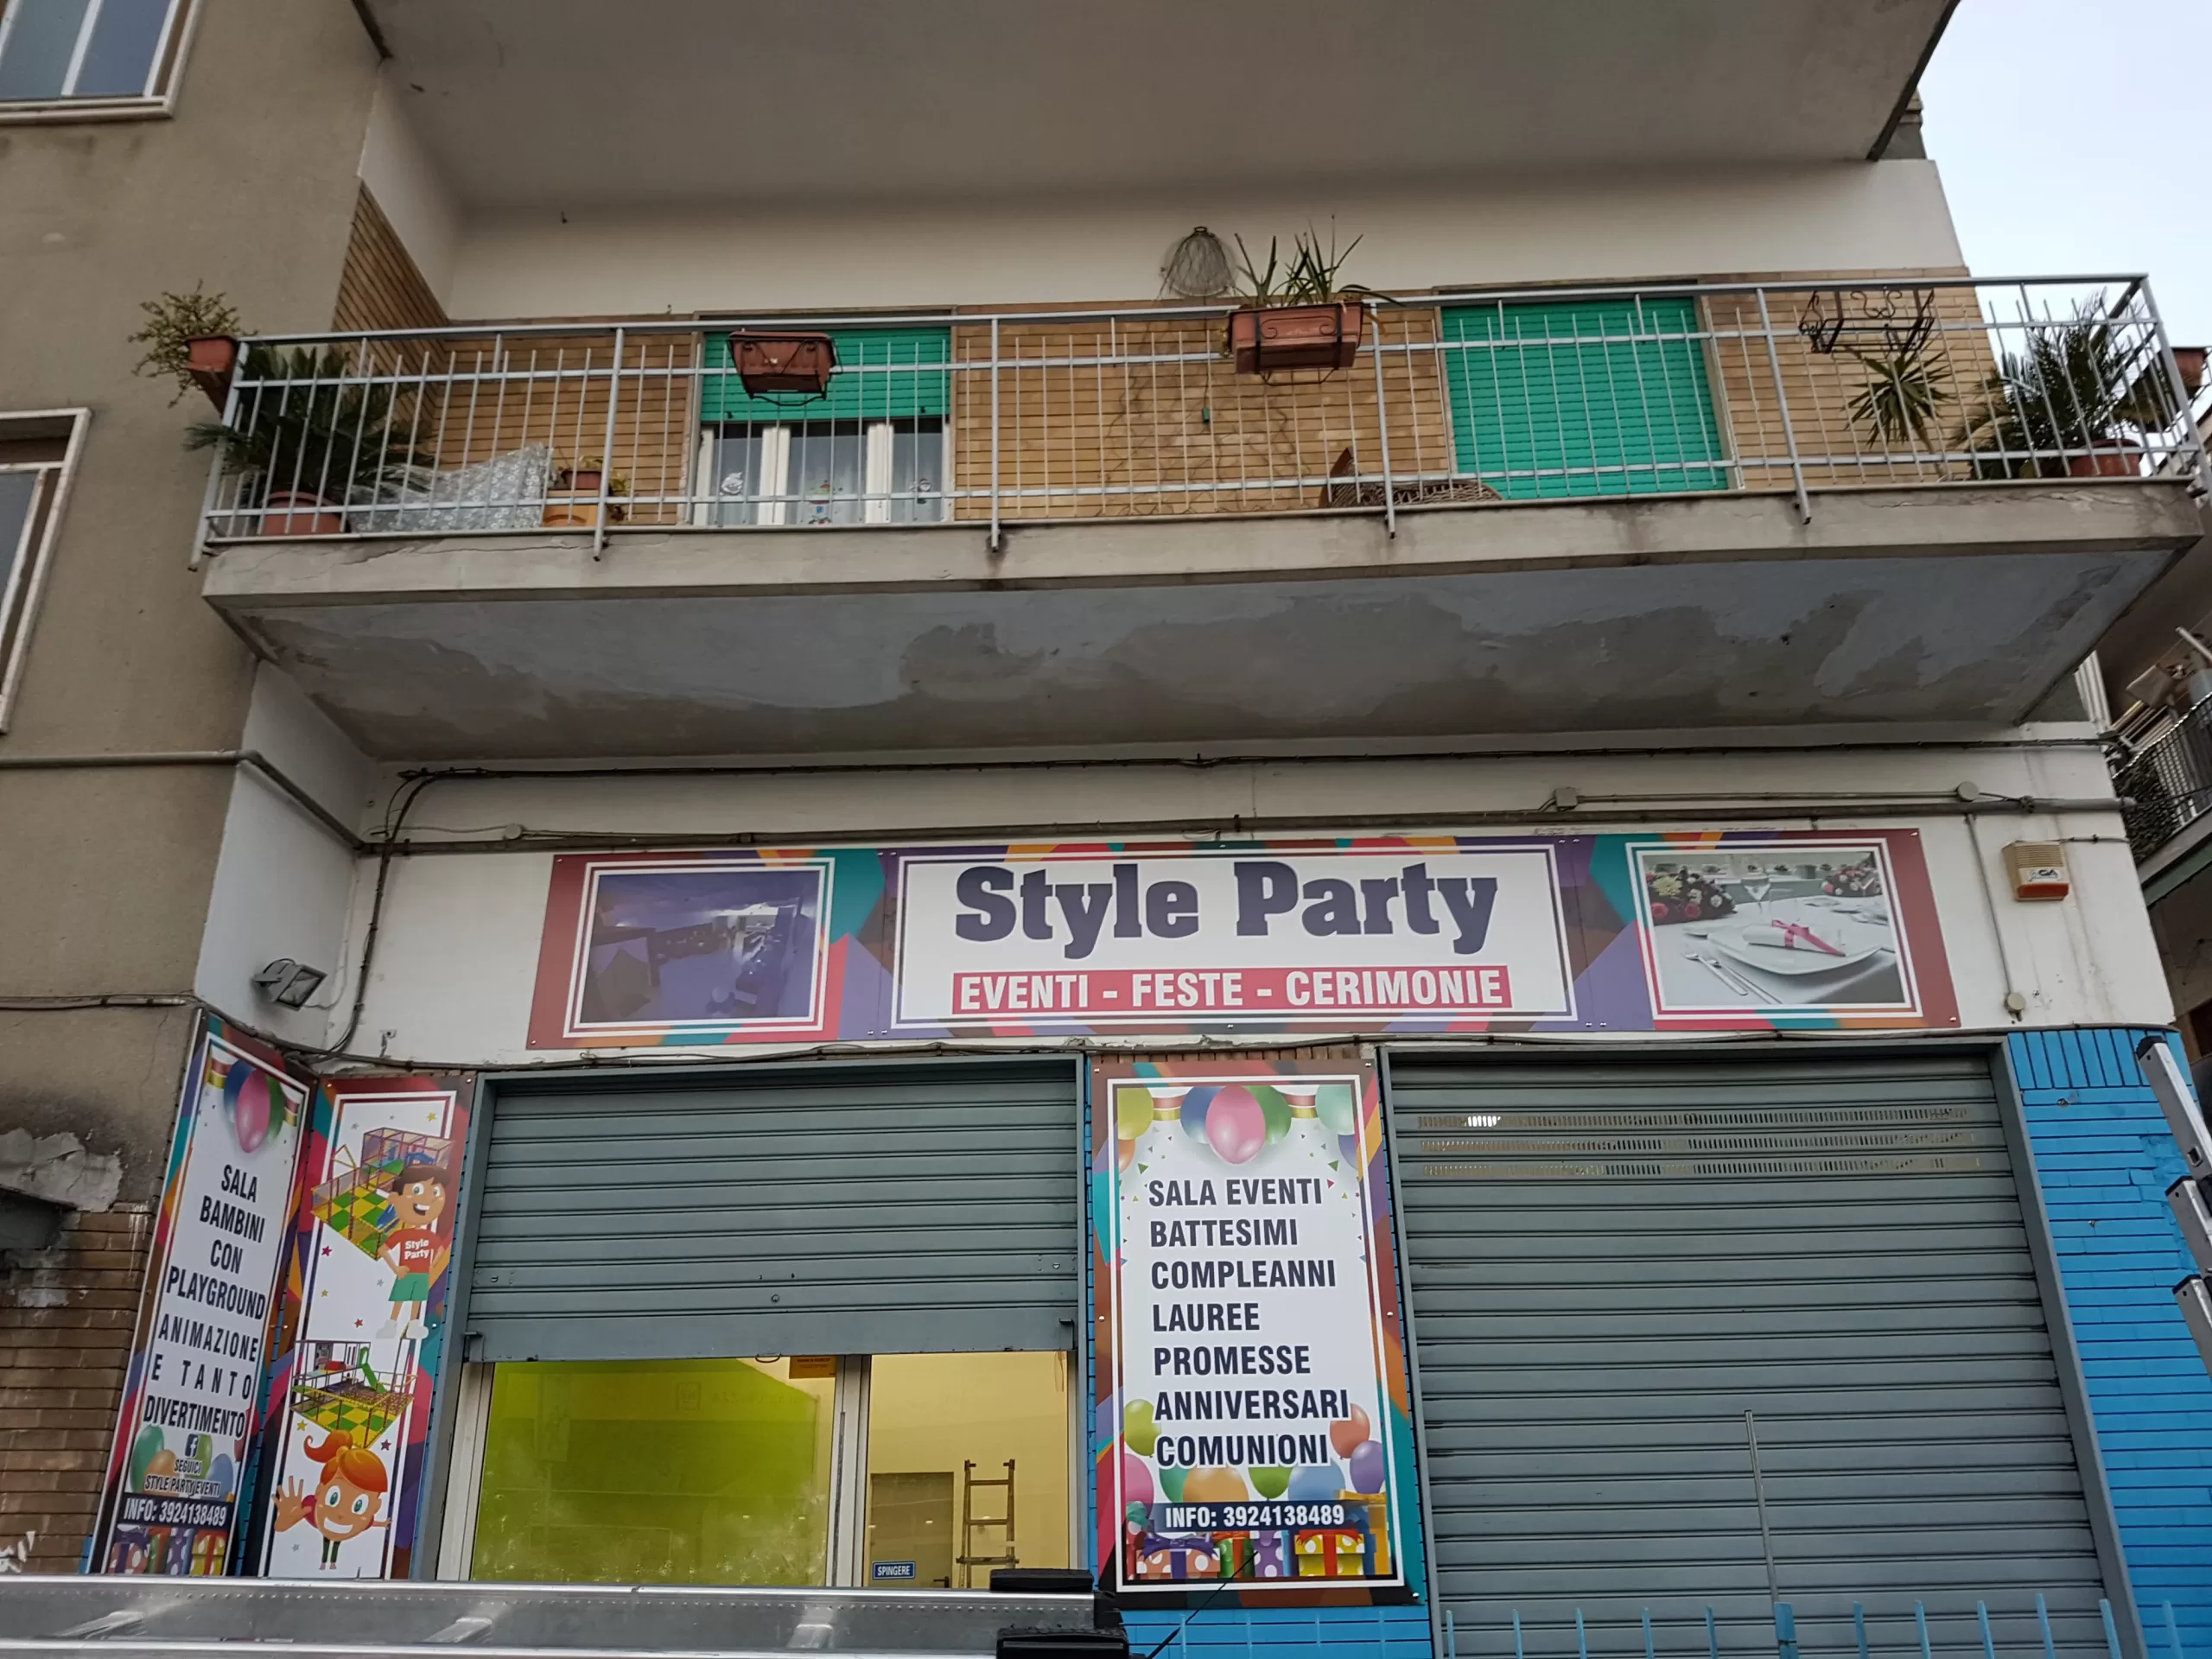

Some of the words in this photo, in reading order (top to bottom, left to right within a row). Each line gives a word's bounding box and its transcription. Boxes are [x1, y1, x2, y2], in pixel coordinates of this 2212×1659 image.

[954, 862, 1199, 959] Style
[1234, 861, 1498, 955] Party
[960, 975, 1089, 1010] EVENTI
[1132, 972, 1243, 1008] FESTE
[1287, 969, 1503, 1006] CERIMONIE
[221, 1164, 257, 1203] SALA
[1148, 1179, 1217, 1206] SALA
[1226, 1178, 1322, 1205] EVENTI
[200, 1195, 265, 1243] BAMBINI
[1150, 1218, 1298, 1247] BATTESIMI
[210, 1239, 243, 1274] CON
[404, 1249, 430, 1260] Party
[405, 1238, 429, 1250] Style
[1151, 1260, 1336, 1289] COMPLEANNI
[167, 1266, 266, 1320] PLAYGROUND
[1153, 1303, 1260, 1332] LAUREE
[158, 1313, 258, 1363] ANIMAZIONE
[1154, 1345, 1311, 1376] PROMESSE
[151, 1354, 163, 1381] E
[181, 1360, 251, 1400] TANTO
[143, 1395, 245, 1439] DIVERTIMENTO
[1154, 1389, 1350, 1421] ANNIVERSARI
[1157, 1434, 1328, 1466] COMUNIONI
[174, 1459, 202, 1474] SEGUICI
[145, 1475, 169, 1491] STYLE
[195, 1480, 220, 1497] EVENTI
[124, 1497, 157, 1521] INFO:
[159, 1501, 227, 1526] 3924138489
[1166, 1507, 1217, 1528] INFO:
[1224, 1505, 1344, 1527] 3924138489
[878, 1566, 910, 1576] SPINGERE
